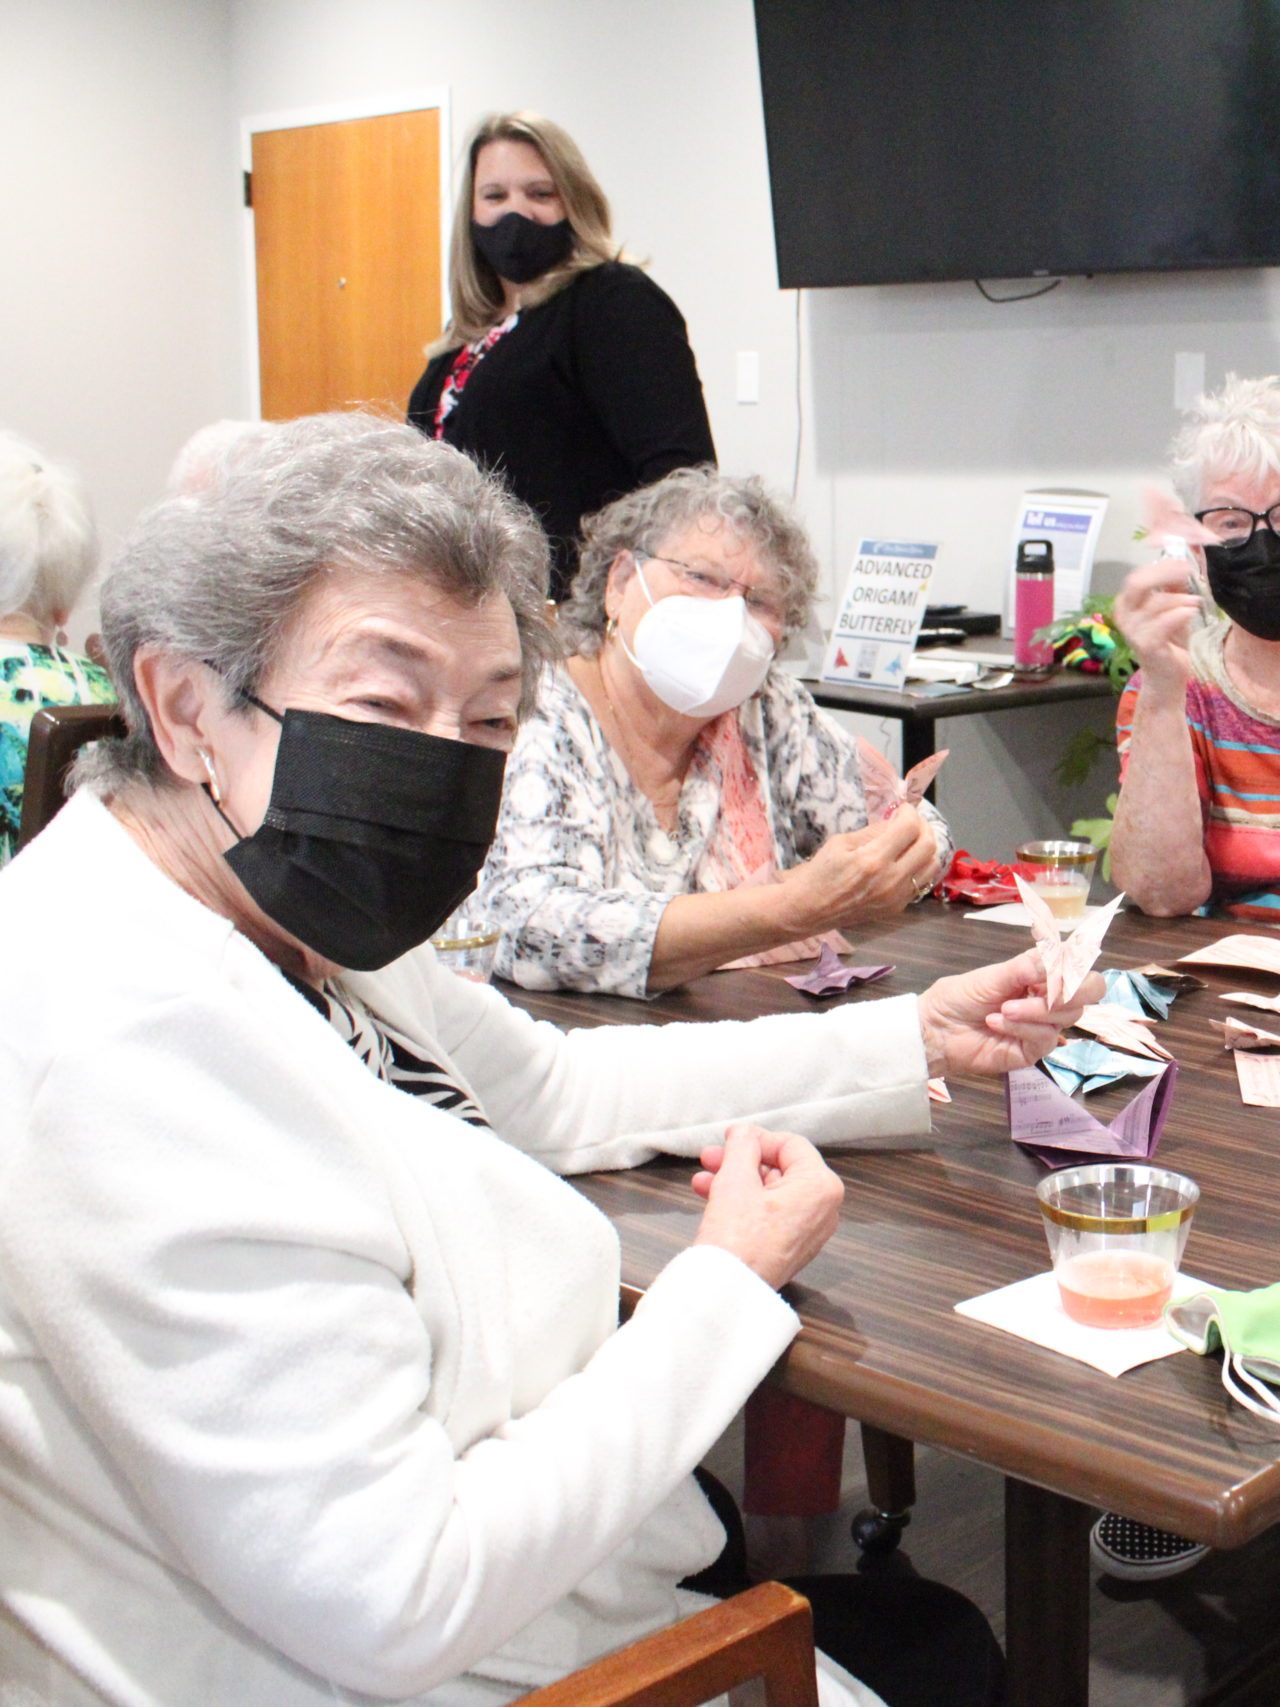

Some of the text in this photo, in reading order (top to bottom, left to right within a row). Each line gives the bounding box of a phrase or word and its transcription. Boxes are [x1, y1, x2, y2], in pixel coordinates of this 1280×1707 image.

[854, 560, 933, 580] ADVANCED
[853, 587, 919, 608] ORIGAMI
[839, 614, 918, 636] BUTTERFLY
